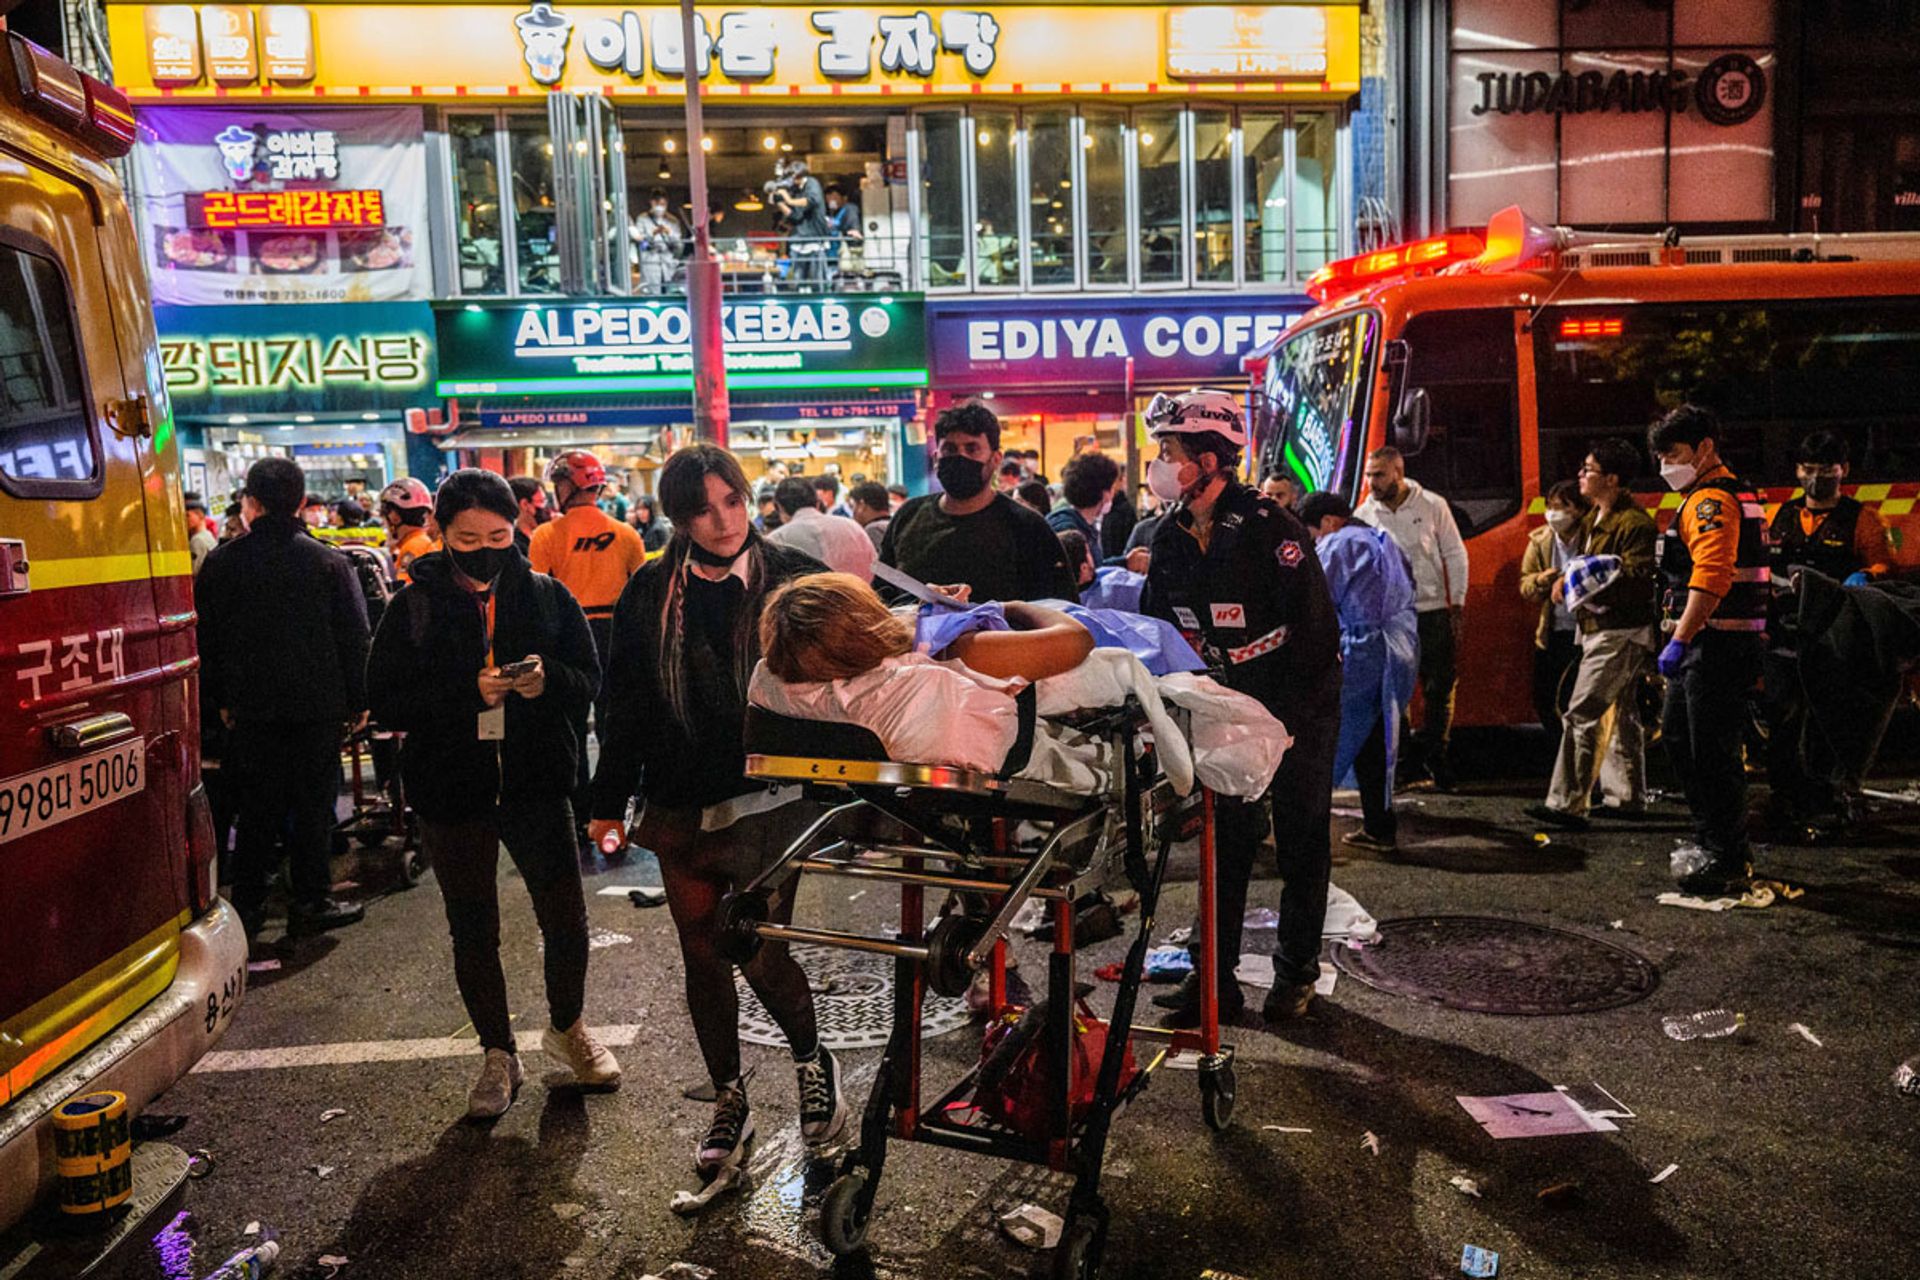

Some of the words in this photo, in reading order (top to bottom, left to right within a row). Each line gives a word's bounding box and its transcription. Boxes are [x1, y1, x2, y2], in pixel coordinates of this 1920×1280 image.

[1471, 69, 1690, 115] JUDABANG
[514, 307, 692, 347] ALPEDO
[967, 318, 1129, 360] EDIYA
[1143, 314, 1303, 357] COFF
[500, 412, 545, 424] ALPEDO
[548, 412, 587, 424] KEBAB
[800, 407, 819, 417] TEL
[573, 532, 615, 552] 119
[1216, 606, 1242, 620] 119
[17, 628, 125, 700] 구조대
[80, 748, 138, 806] 5006
